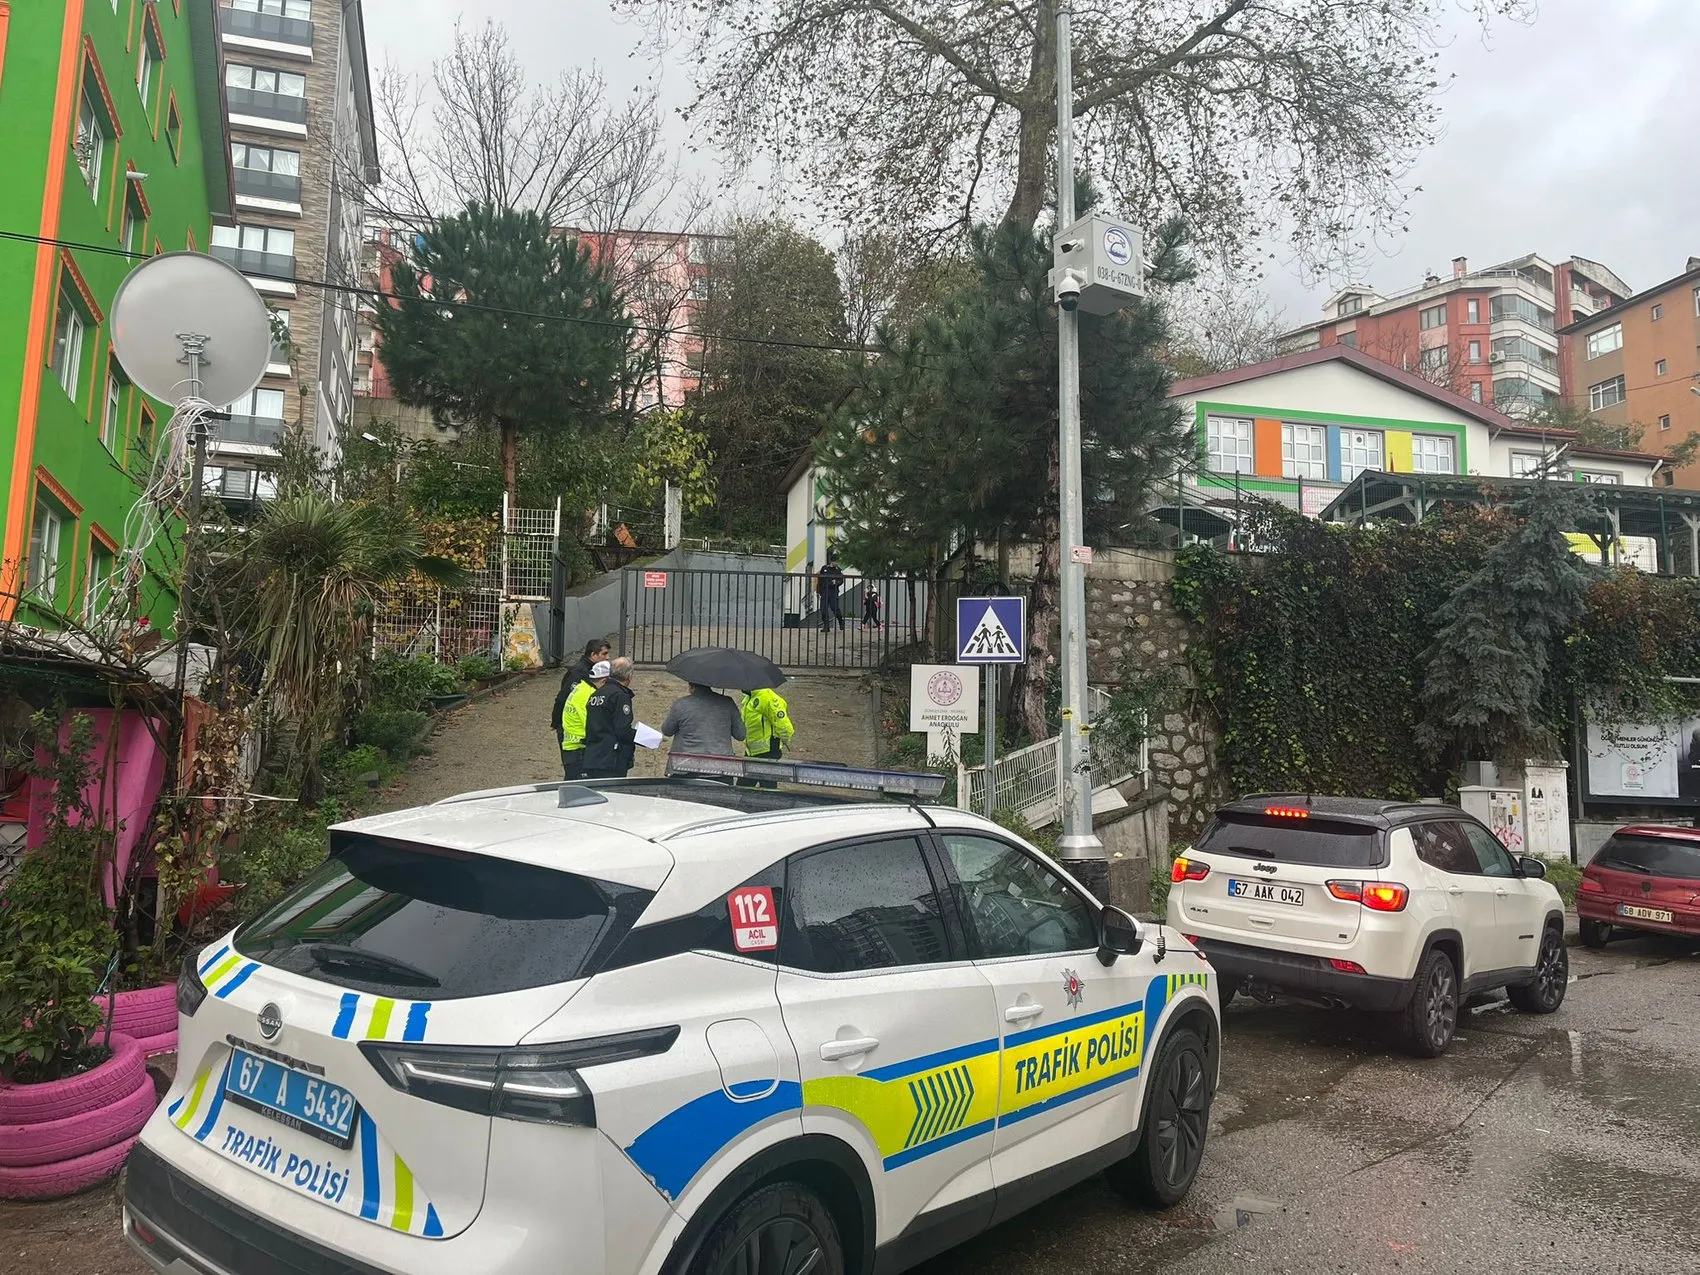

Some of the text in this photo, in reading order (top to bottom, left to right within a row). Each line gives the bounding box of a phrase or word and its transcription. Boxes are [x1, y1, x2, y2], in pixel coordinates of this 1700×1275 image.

[1253, 863, 1277, 874] Jeep
[1235, 882, 1302, 903] 67 AAK 042
[735, 893, 770, 923] 112
[1623, 906, 1634, 915] 68
[1655, 912, 1671, 921] 971
[258, 1014, 281, 1027] SSAN
[1015, 1016, 1138, 1094] TRAFİK POLİSİ
[239, 1057, 352, 1132] 67 A 5432
[261, 1106, 302, 1130] KELESSAN
[222, 1125, 350, 1203] TRAFİK POLİSİ
